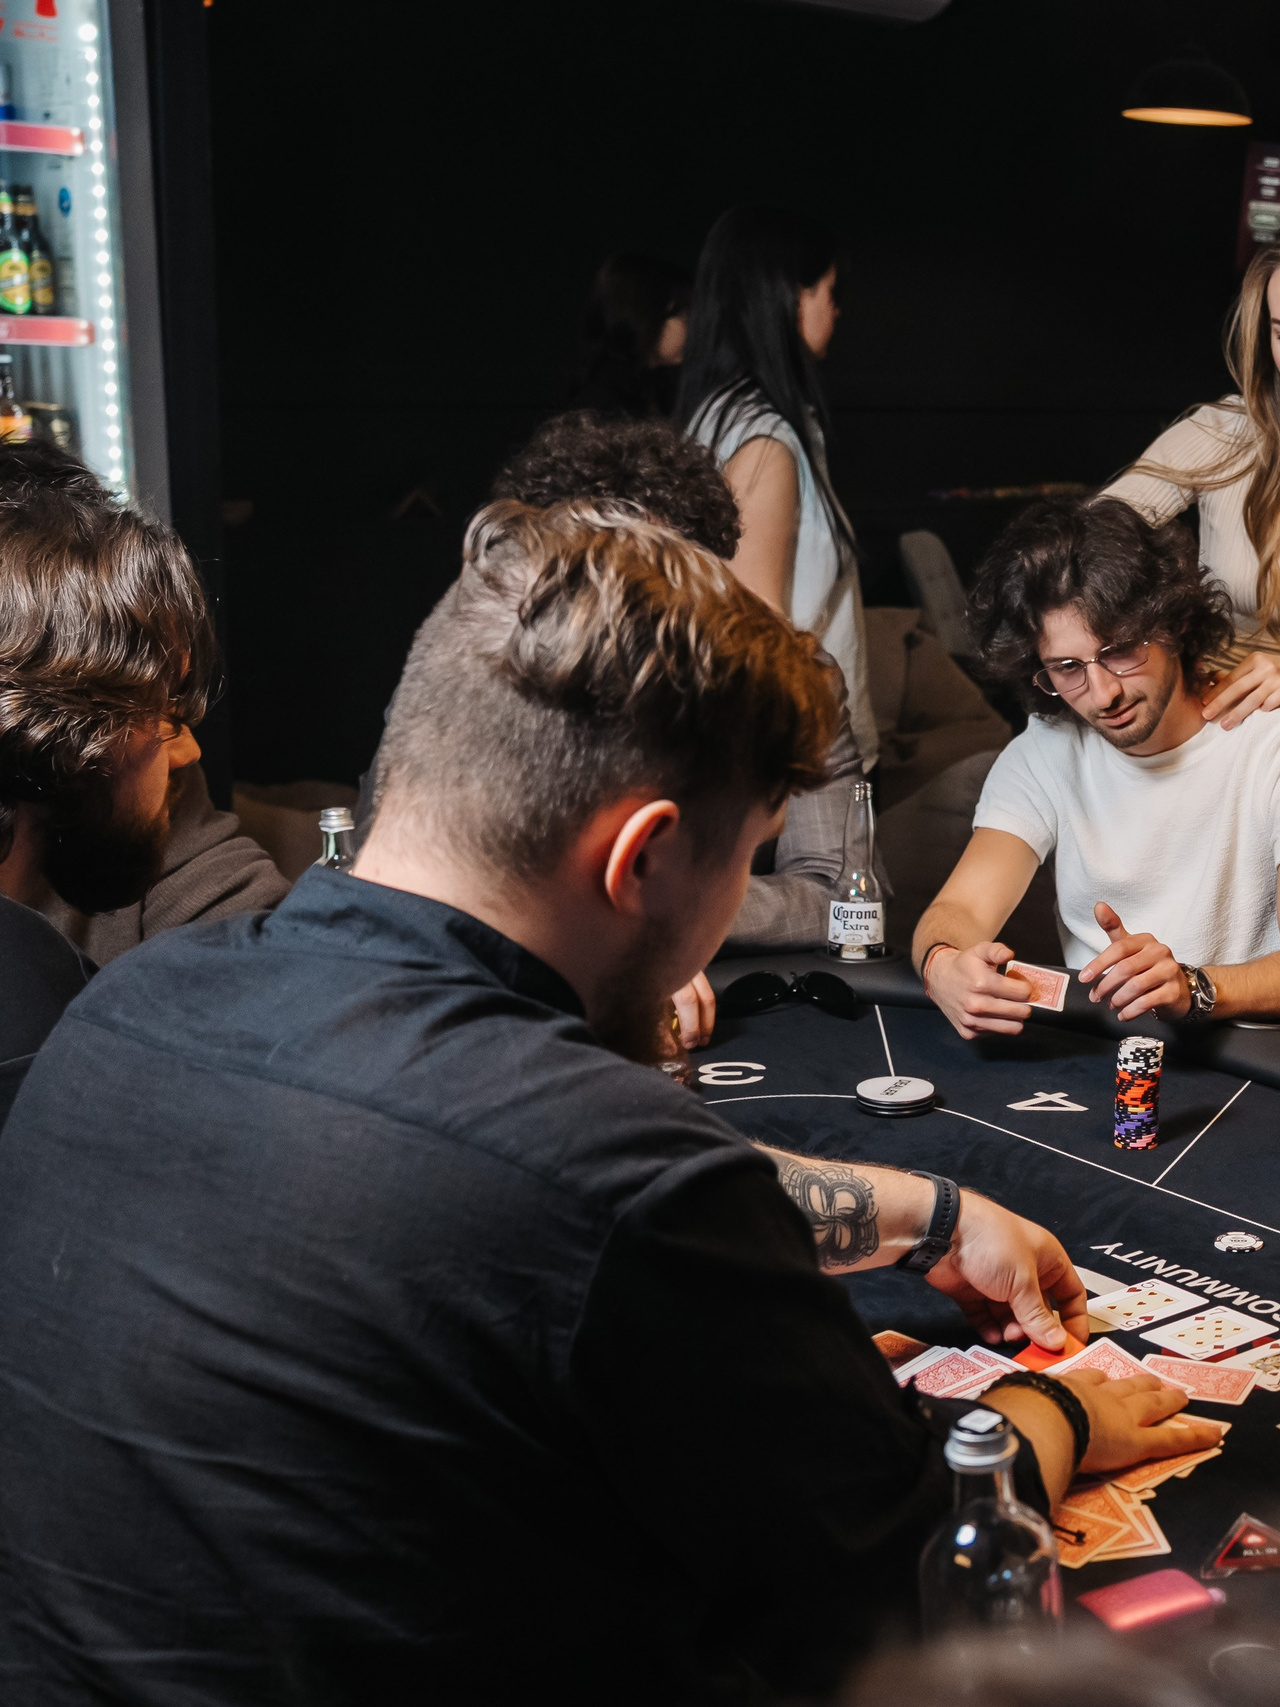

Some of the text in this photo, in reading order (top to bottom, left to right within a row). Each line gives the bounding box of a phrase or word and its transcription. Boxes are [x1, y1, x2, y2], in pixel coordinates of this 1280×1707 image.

[833, 905, 879, 921] Corona
[843, 921, 869, 930] Extra
[880, 1079, 911, 1096] DEALER
[1006, 1091, 1088, 1112] 4
